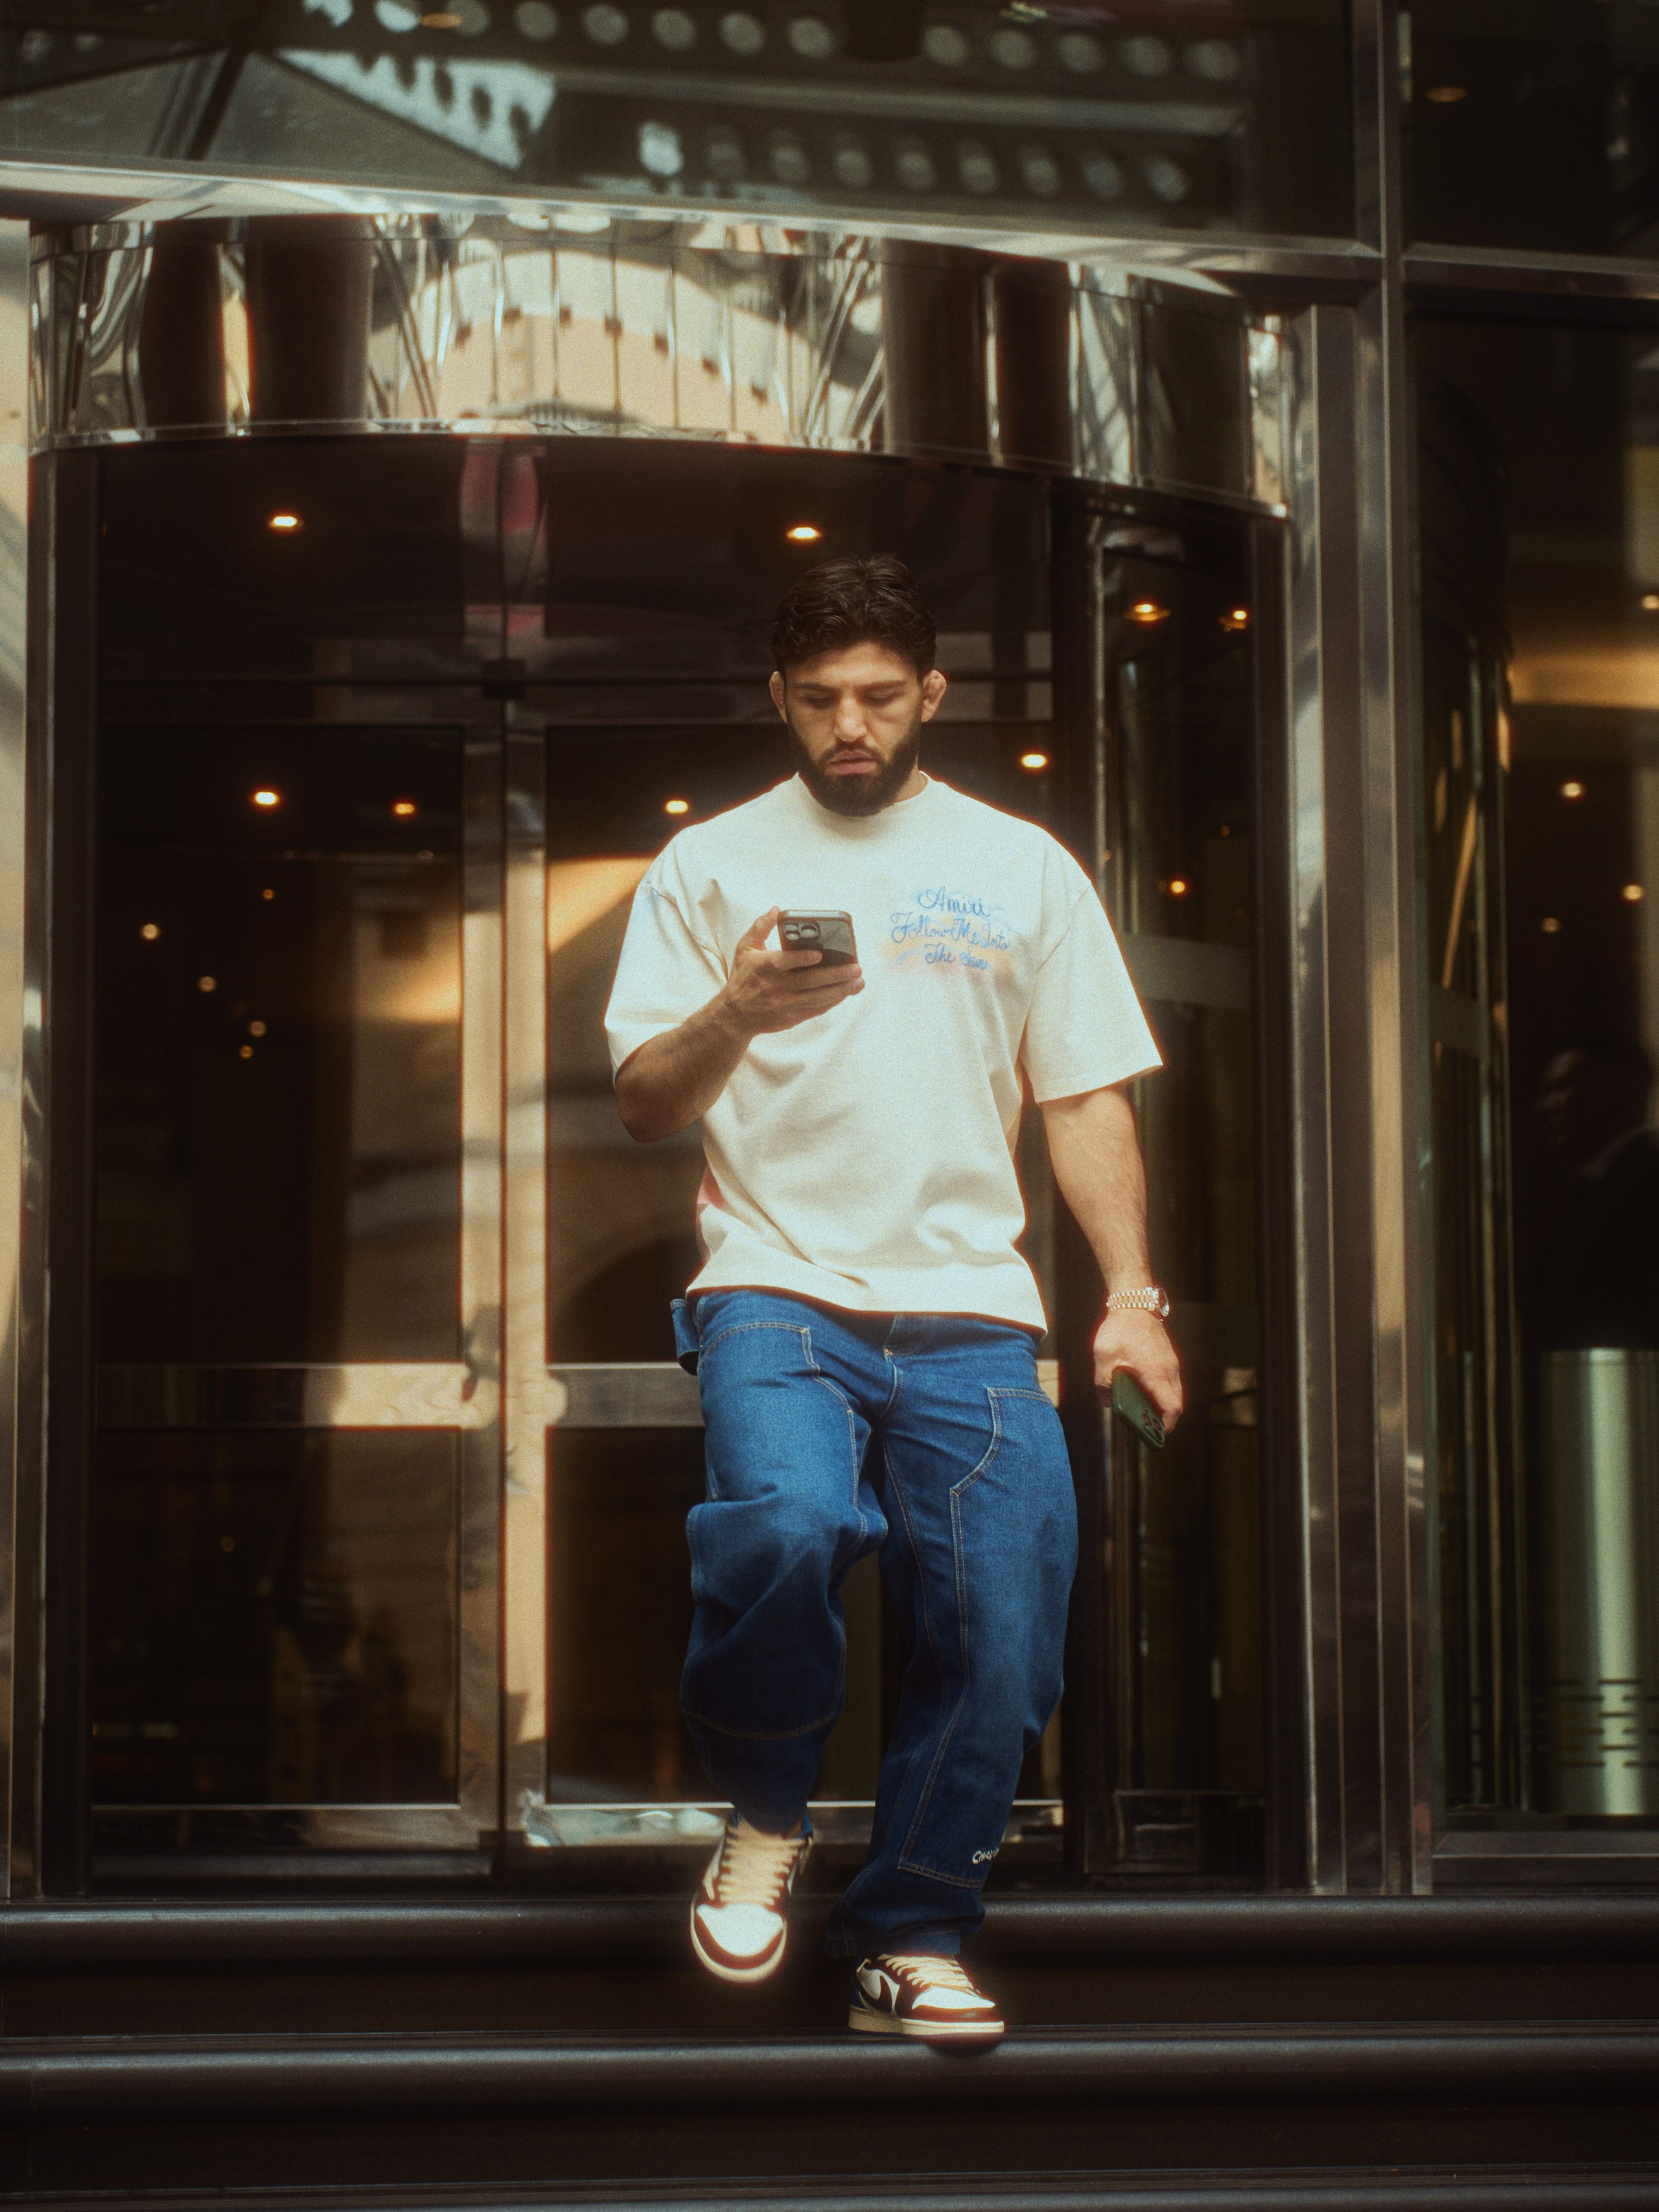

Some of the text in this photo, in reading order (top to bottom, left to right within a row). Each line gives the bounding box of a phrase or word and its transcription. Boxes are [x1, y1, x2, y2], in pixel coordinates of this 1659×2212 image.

[918, 886, 990, 916] Amiri
[890, 911, 1010, 950] Follow Me Into
[924, 942, 957, 964] The
